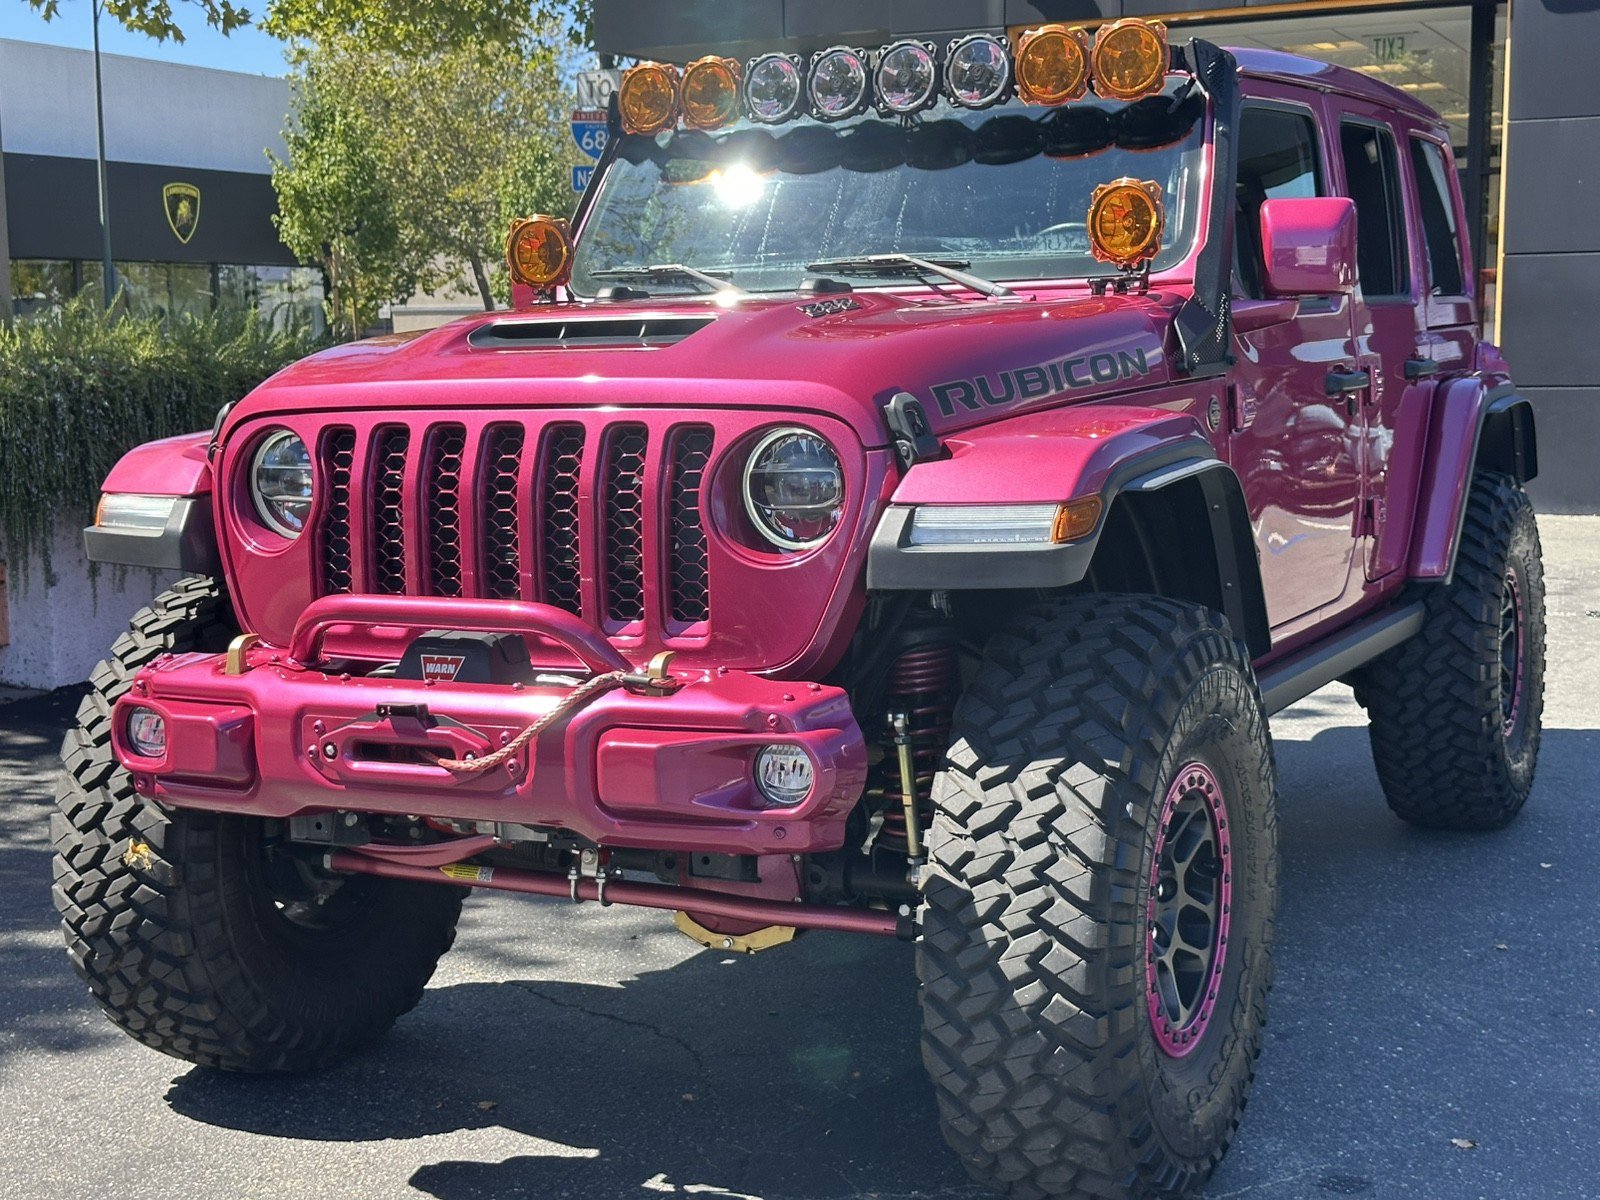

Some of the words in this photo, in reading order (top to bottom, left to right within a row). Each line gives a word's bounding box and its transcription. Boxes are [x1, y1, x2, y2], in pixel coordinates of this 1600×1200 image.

[587, 79, 612, 99] TO
[582, 130, 607, 150] 68
[930, 347, 1150, 417] RUBICON
[425, 662, 456, 674] WARN
